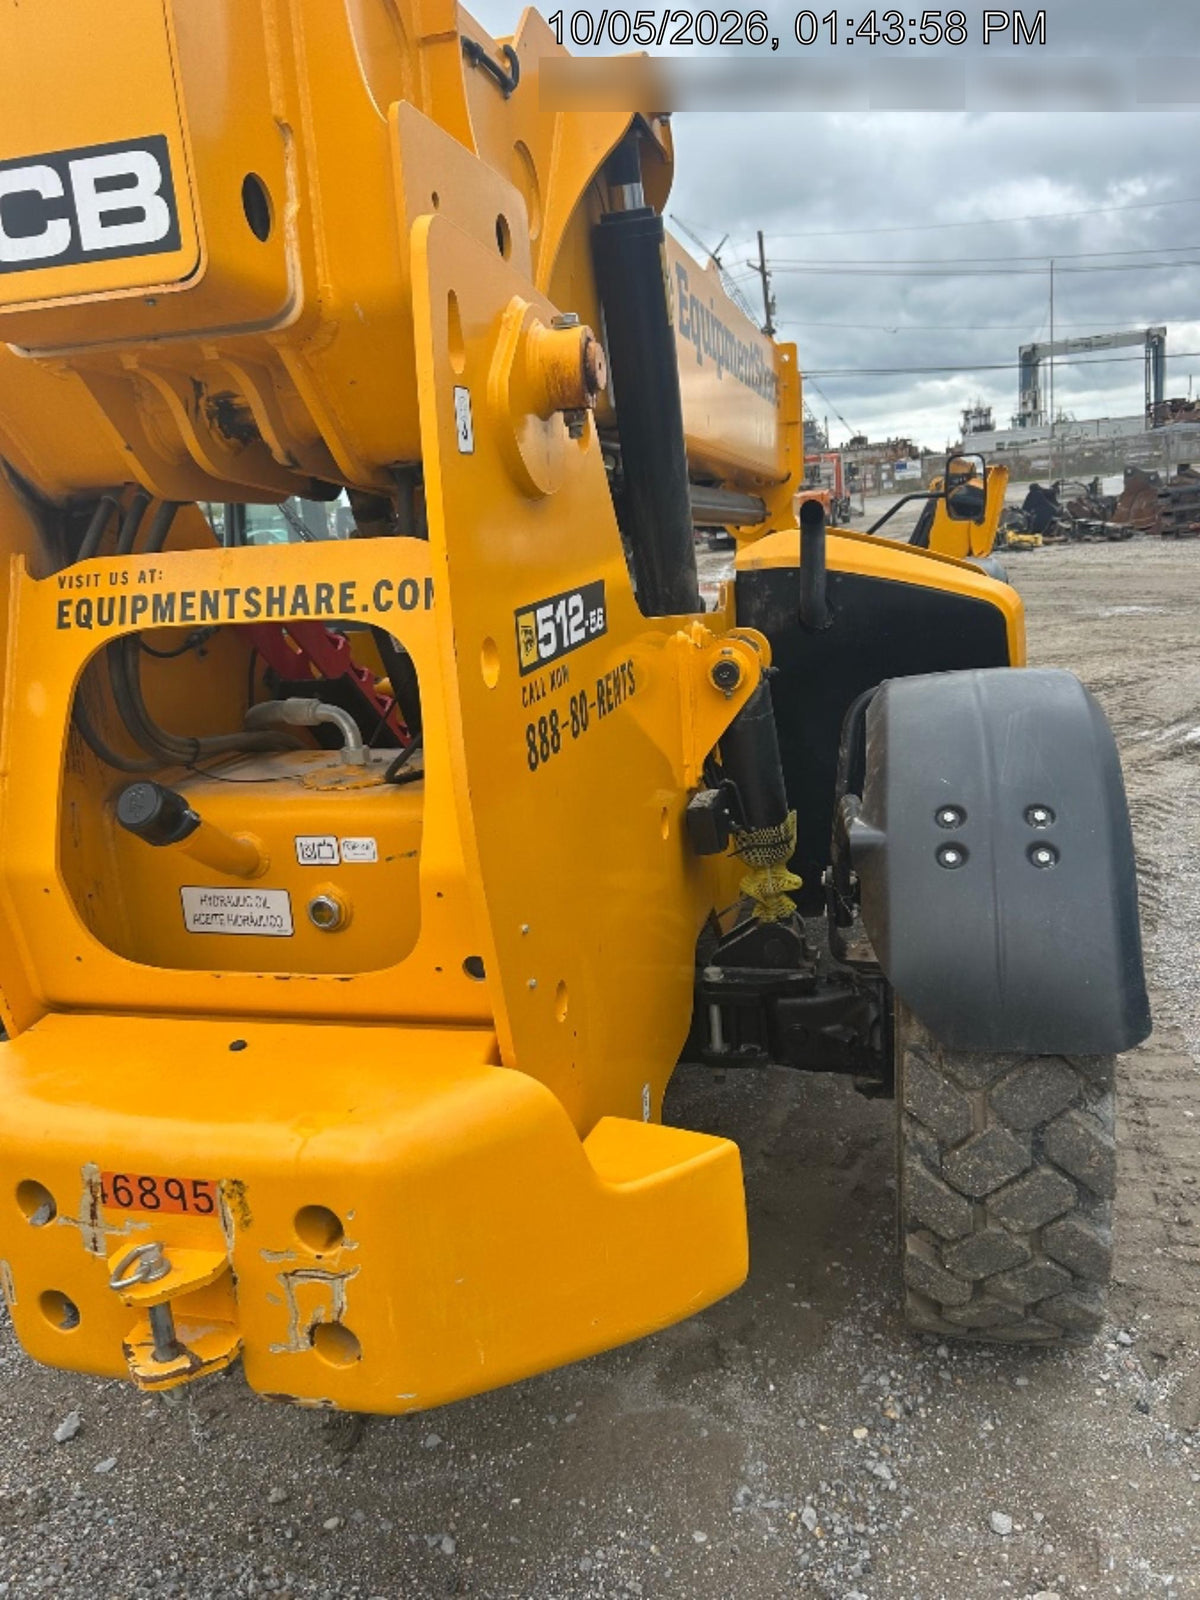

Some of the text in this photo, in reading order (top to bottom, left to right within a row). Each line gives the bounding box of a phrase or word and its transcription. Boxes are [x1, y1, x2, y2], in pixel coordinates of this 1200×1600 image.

[57, 569, 163, 590] VISIT US AT:
[521, 677, 546, 708] CALL
[526, 659, 636, 771] 888-80-RENTS
